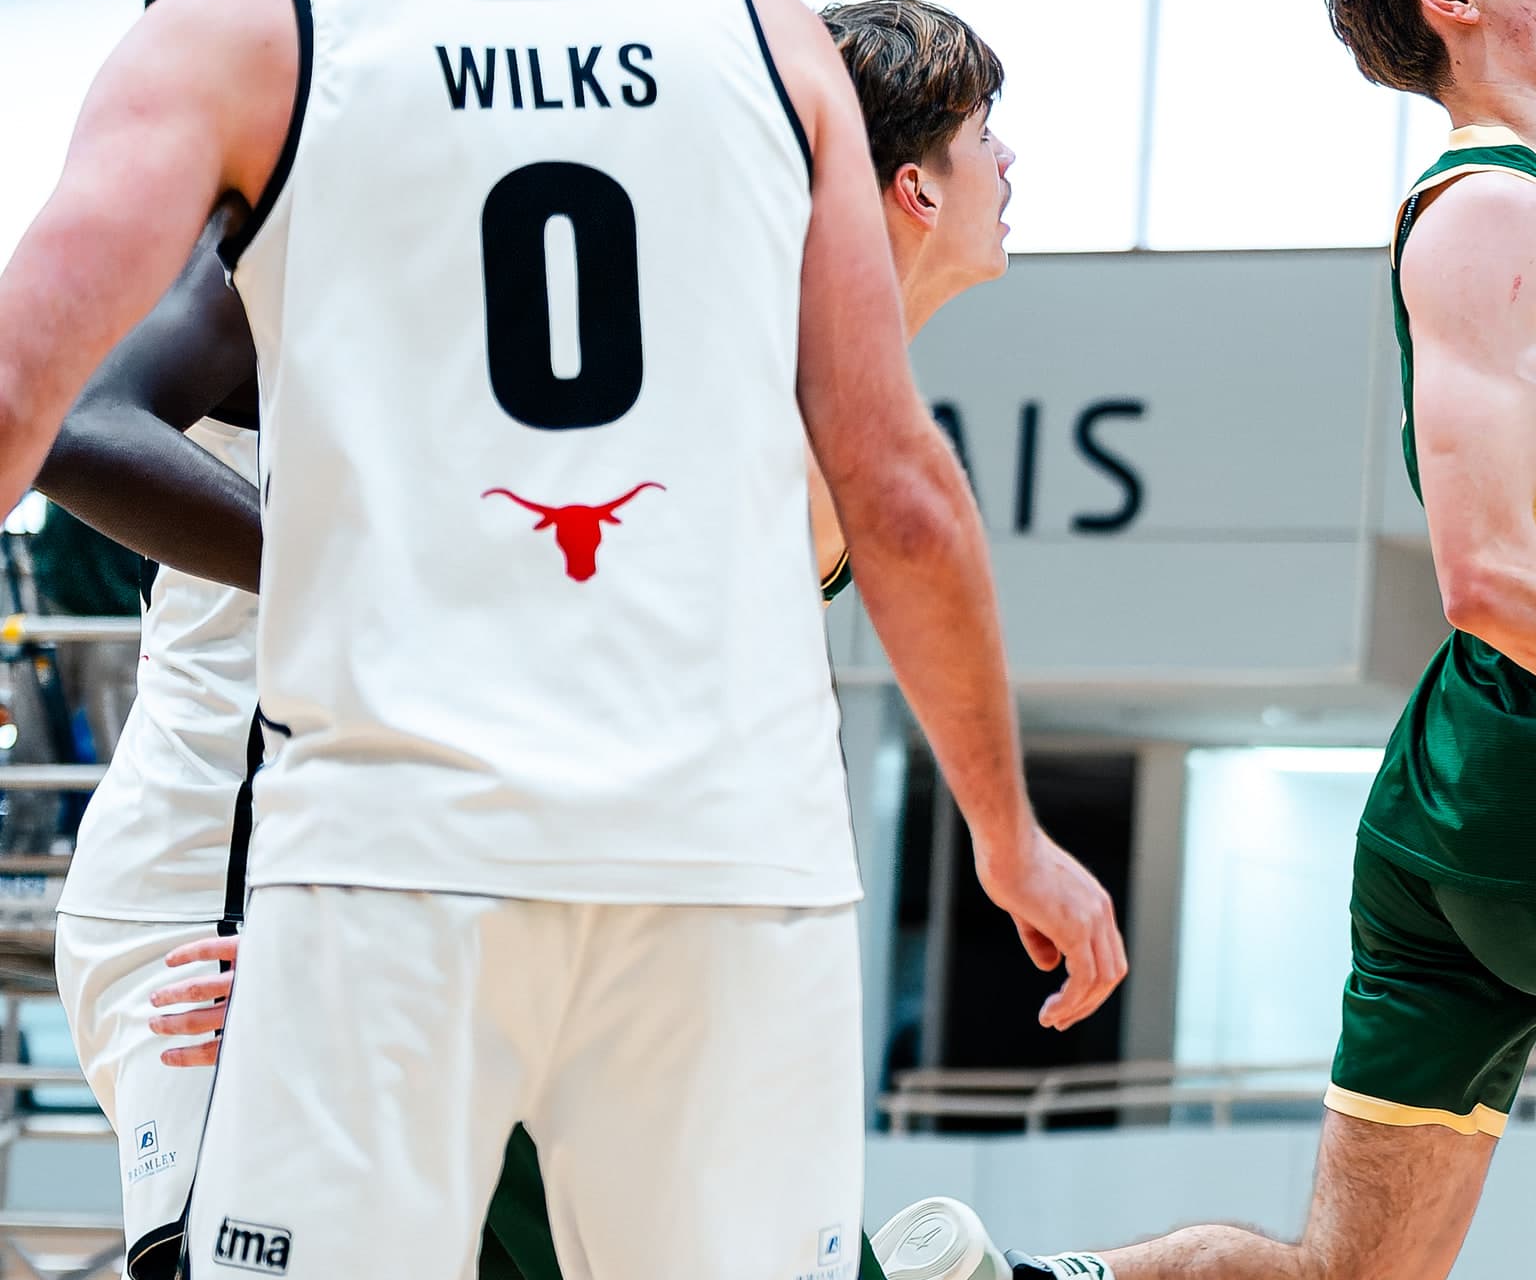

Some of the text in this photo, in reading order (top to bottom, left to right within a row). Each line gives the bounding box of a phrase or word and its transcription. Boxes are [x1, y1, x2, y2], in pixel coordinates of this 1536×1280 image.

[435, 43, 659, 110] WILKS
[481, 161, 644, 431] 0
[215, 1216, 292, 1270] tma
